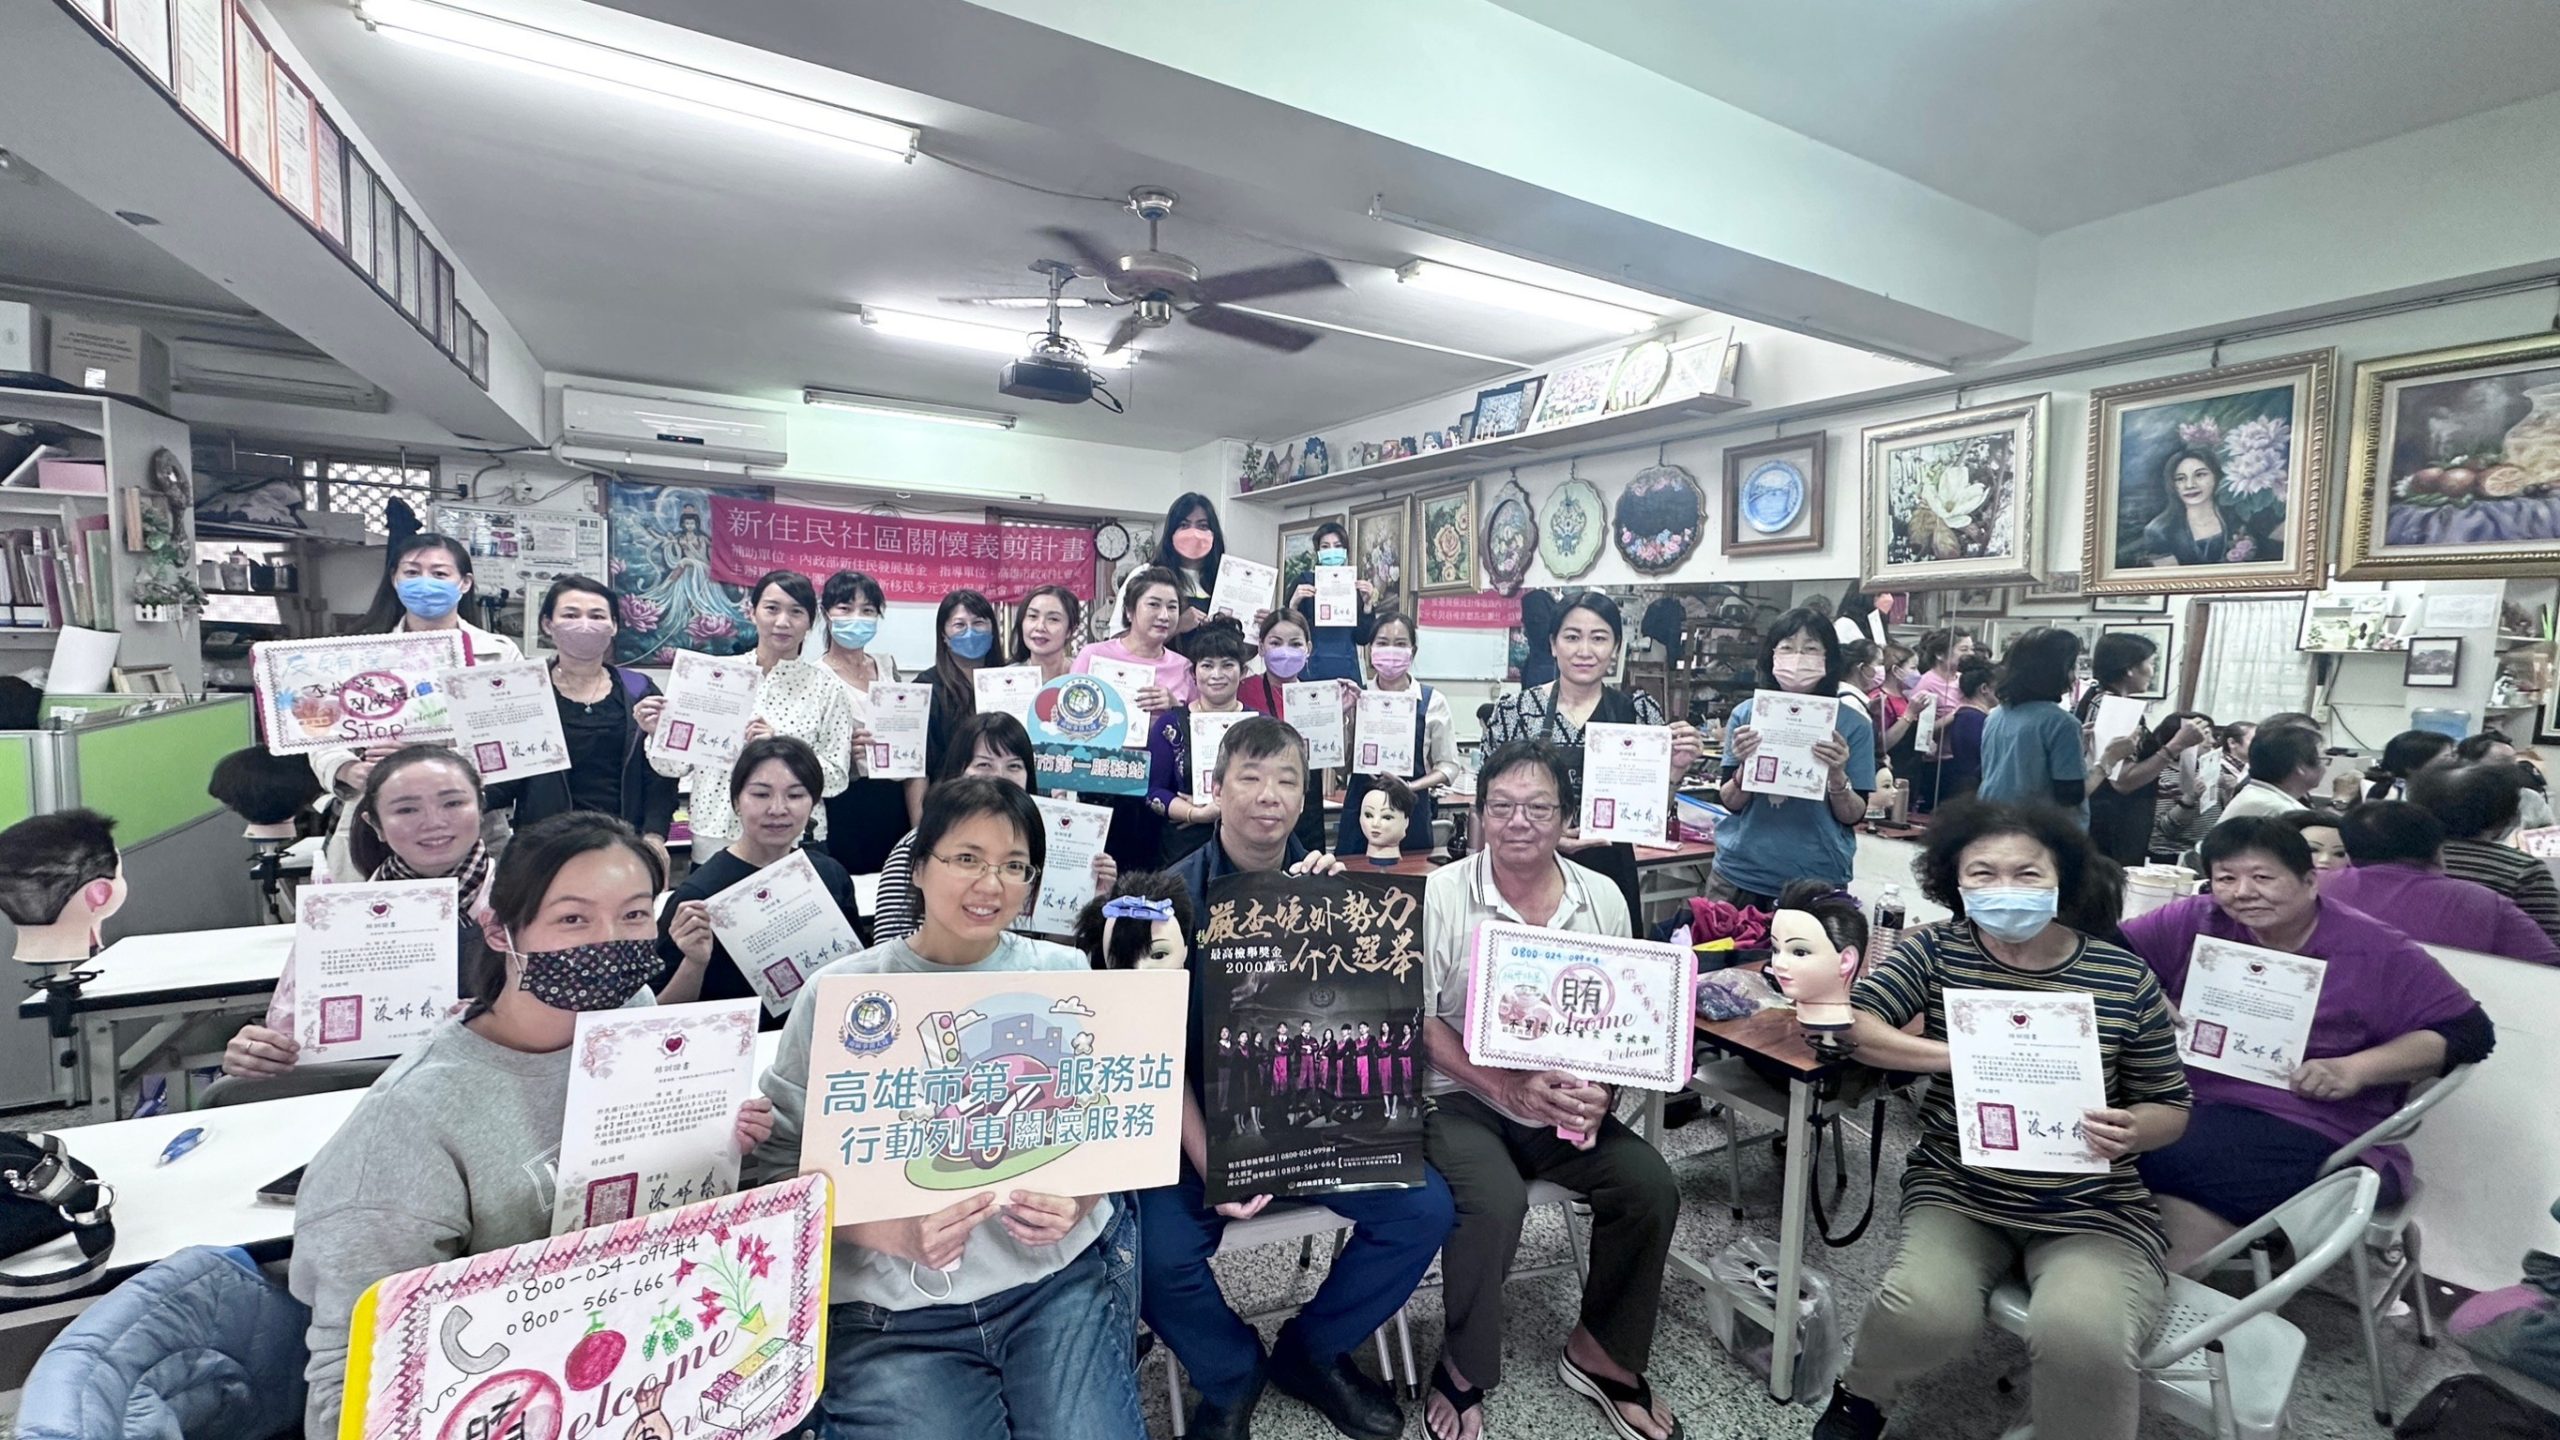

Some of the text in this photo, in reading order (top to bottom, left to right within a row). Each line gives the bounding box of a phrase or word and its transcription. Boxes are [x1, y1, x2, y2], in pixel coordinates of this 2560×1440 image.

[726, 506, 1087, 563] 新住民社區關懷義剪計畫
[338, 718, 405, 743] Stop
[1033, 752, 1146, 780] 市第一服務站
[1210, 945, 1283, 961] 最高檢舉獎金
[1225, 960, 1288, 974] 2000萬元
[1561, 975, 1602, 1016] 賄
[822, 1052, 1175, 1117] 高雄市第一服務站
[838, 1102, 1156, 1167] 行動列車關懷服務
[506, 1237, 700, 1304] 0800-024-099#4
[506, 1277, 665, 1336] 0800-566-666
